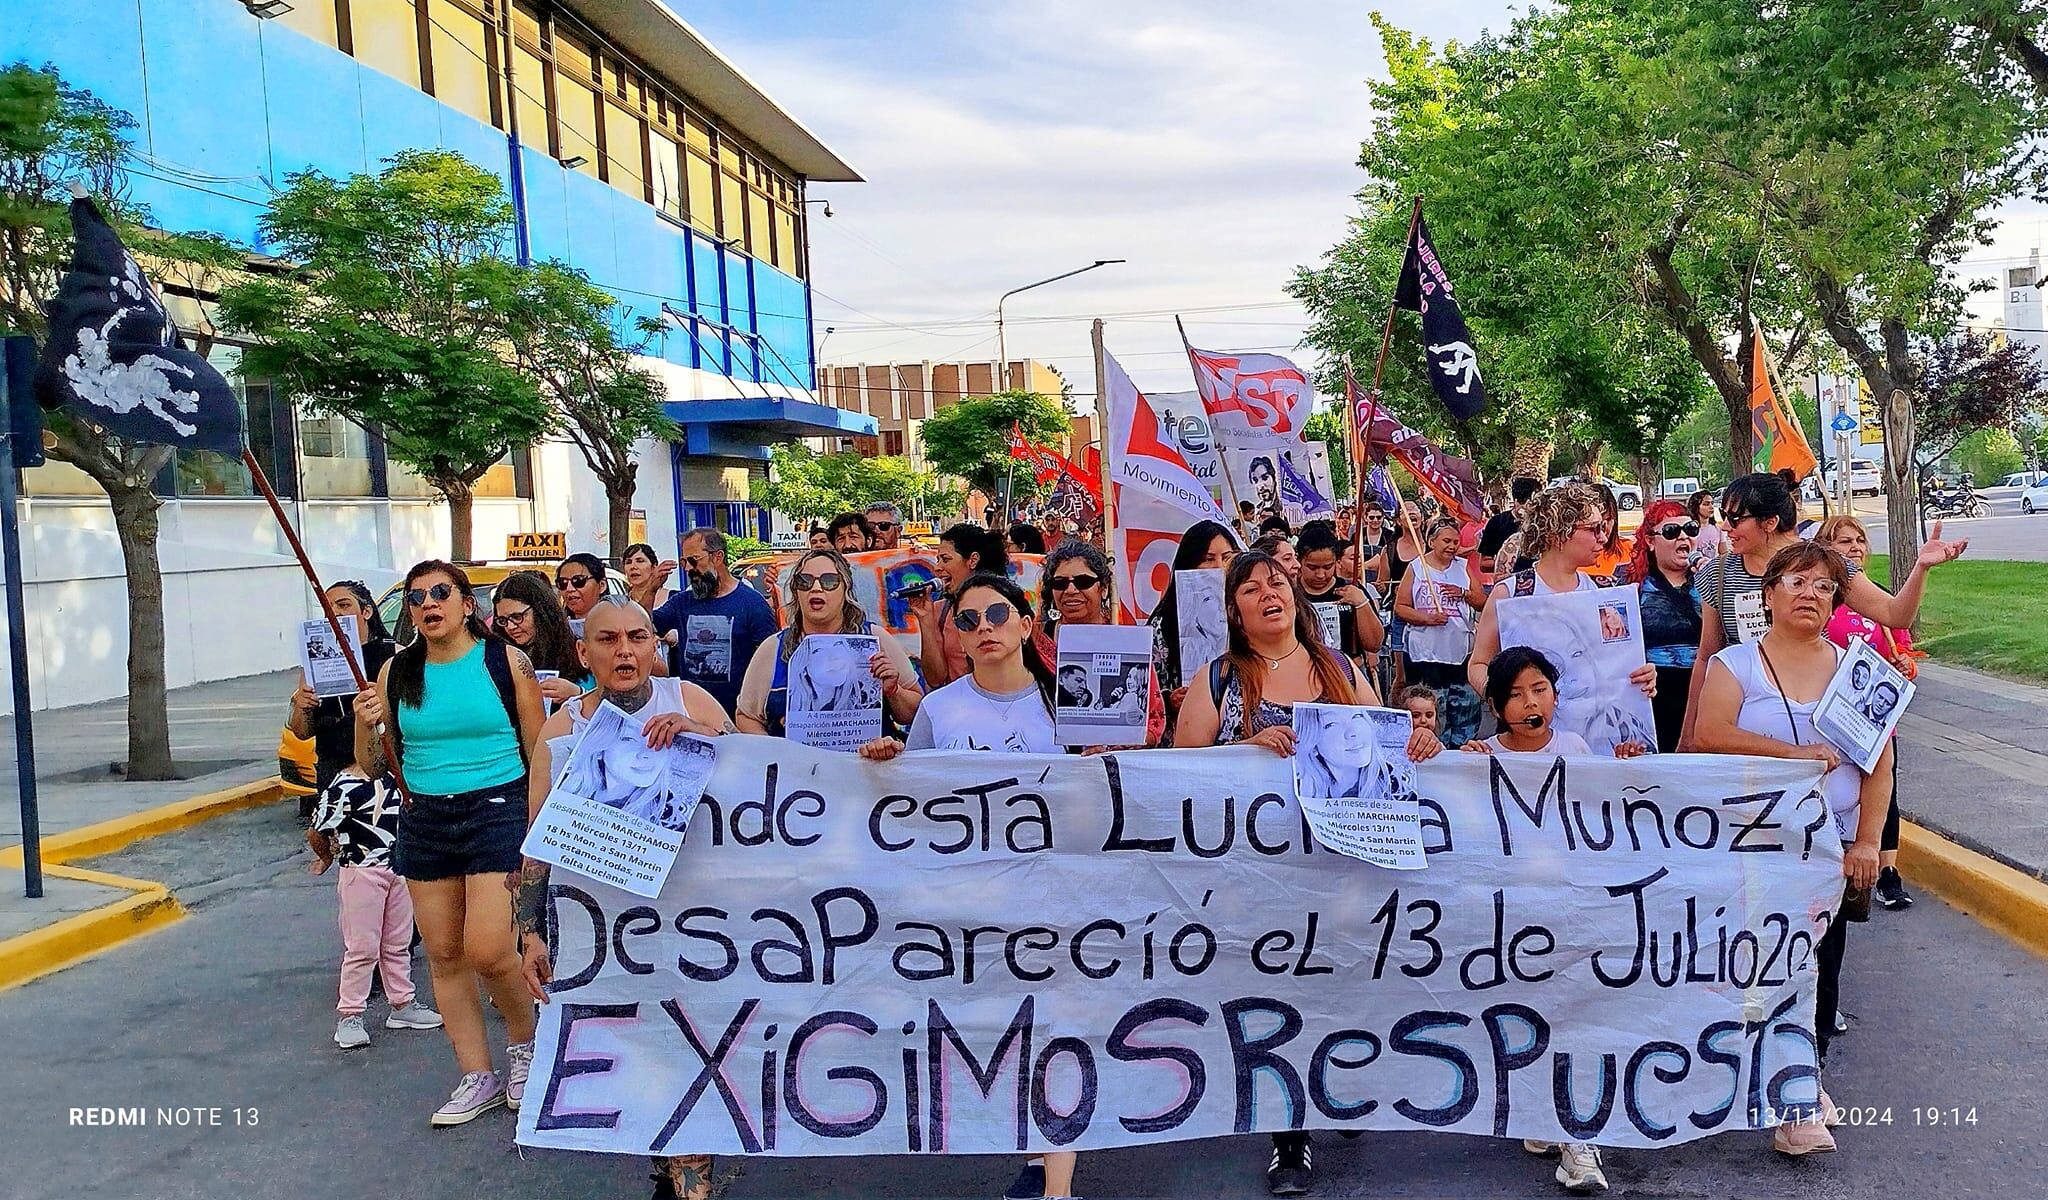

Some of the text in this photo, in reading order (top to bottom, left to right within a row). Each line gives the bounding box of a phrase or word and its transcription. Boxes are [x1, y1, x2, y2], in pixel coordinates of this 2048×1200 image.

[2010, 291, 2028, 303] B1
[1123, 461, 1211, 513] Movimiento
[511, 535, 559, 547] TAXI
[777, 532, 801, 541] TAXI
[508, 548, 560, 556] NEUQUEN
[806, 729, 862, 738] Miércoles 13/11
[1324, 800, 1332, 808] A
[1341, 800, 1369, 808] meses
[1370, 800, 1381, 809] de
[1382, 802, 1393, 810] su
[582, 799, 656, 834] A 4 meses de su
[1357, 811, 1419, 823] MARCHAMOS!
[549, 800, 679, 854] desaparición MARCHAMOS!
[1372, 824, 1396, 833] 13/11
[546, 823, 557, 834] 18
[559, 827, 571, 840] hs
[573, 833, 598, 851] Mon.
[600, 843, 607, 853] a
[608, 846, 628, 862] San
[571, 819, 648, 856] Miércoles 13/11
[1366, 835, 1384, 845] San
[1369, 847, 1397, 857] todas,
[1398, 849, 1416, 857] nos
[542, 834, 655, 883] No estamos todas, nos
[559, 854, 629, 888] falta Luciana!
[1370, 888, 1444, 980] 13
[1458, 888, 1556, 991] de
